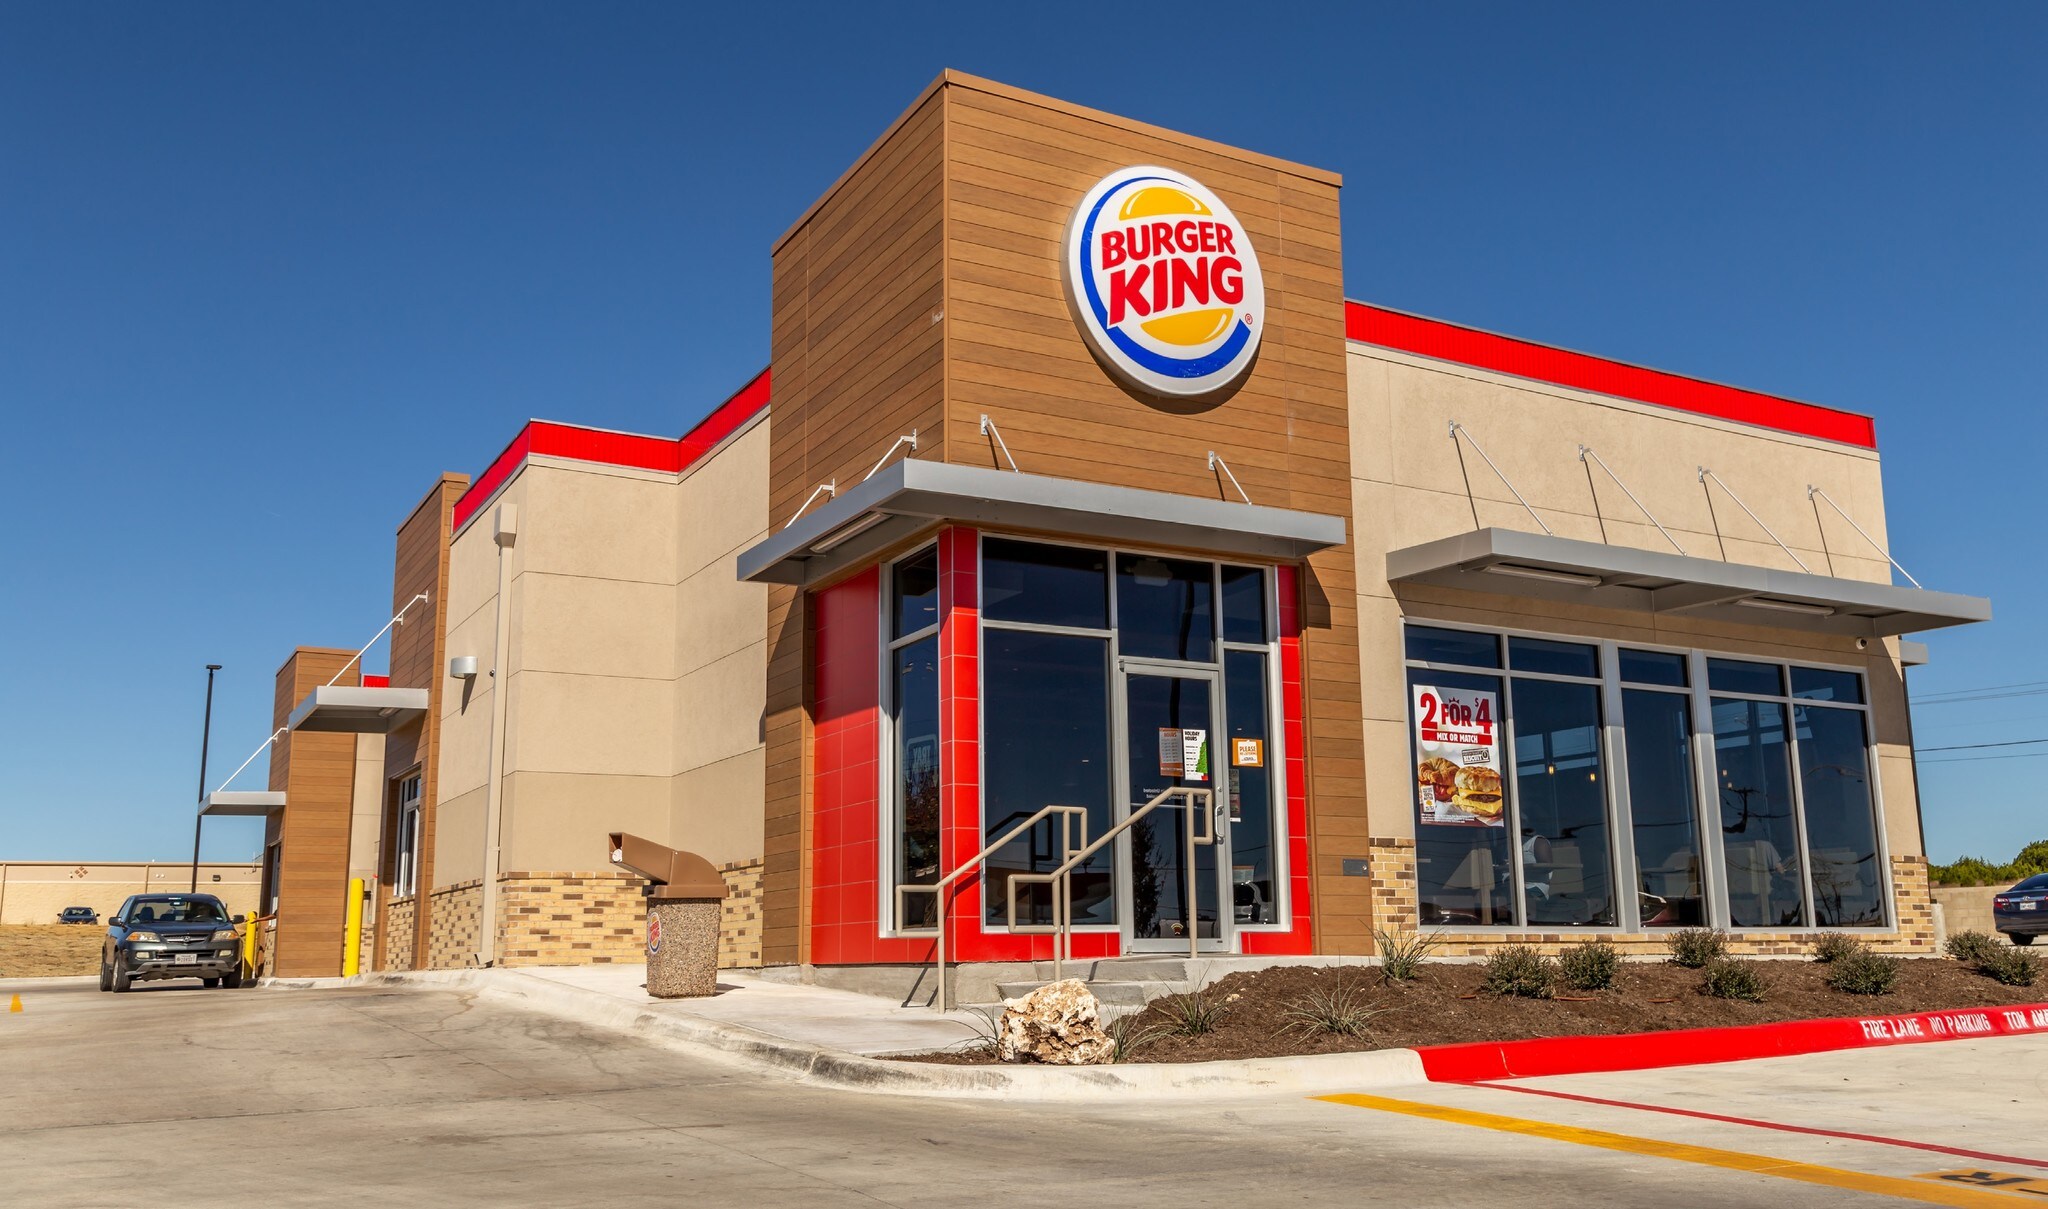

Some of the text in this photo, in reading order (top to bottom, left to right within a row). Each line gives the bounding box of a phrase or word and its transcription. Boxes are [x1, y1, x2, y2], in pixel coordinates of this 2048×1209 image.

[1101, 220, 1236, 270] BURGER
[1109, 256, 1244, 325] KING
[1420, 692, 1438, 729] 2
[1441, 703, 1472, 727] FOR
[1436, 732, 1478, 743] MIX OR MATCH
[1859, 1019, 1891, 1040] FIRE
[1888, 1017, 1924, 1038] LANE
[1928, 1017, 1947, 1035] NO
[1945, 1013, 1991, 1033] PARKING
